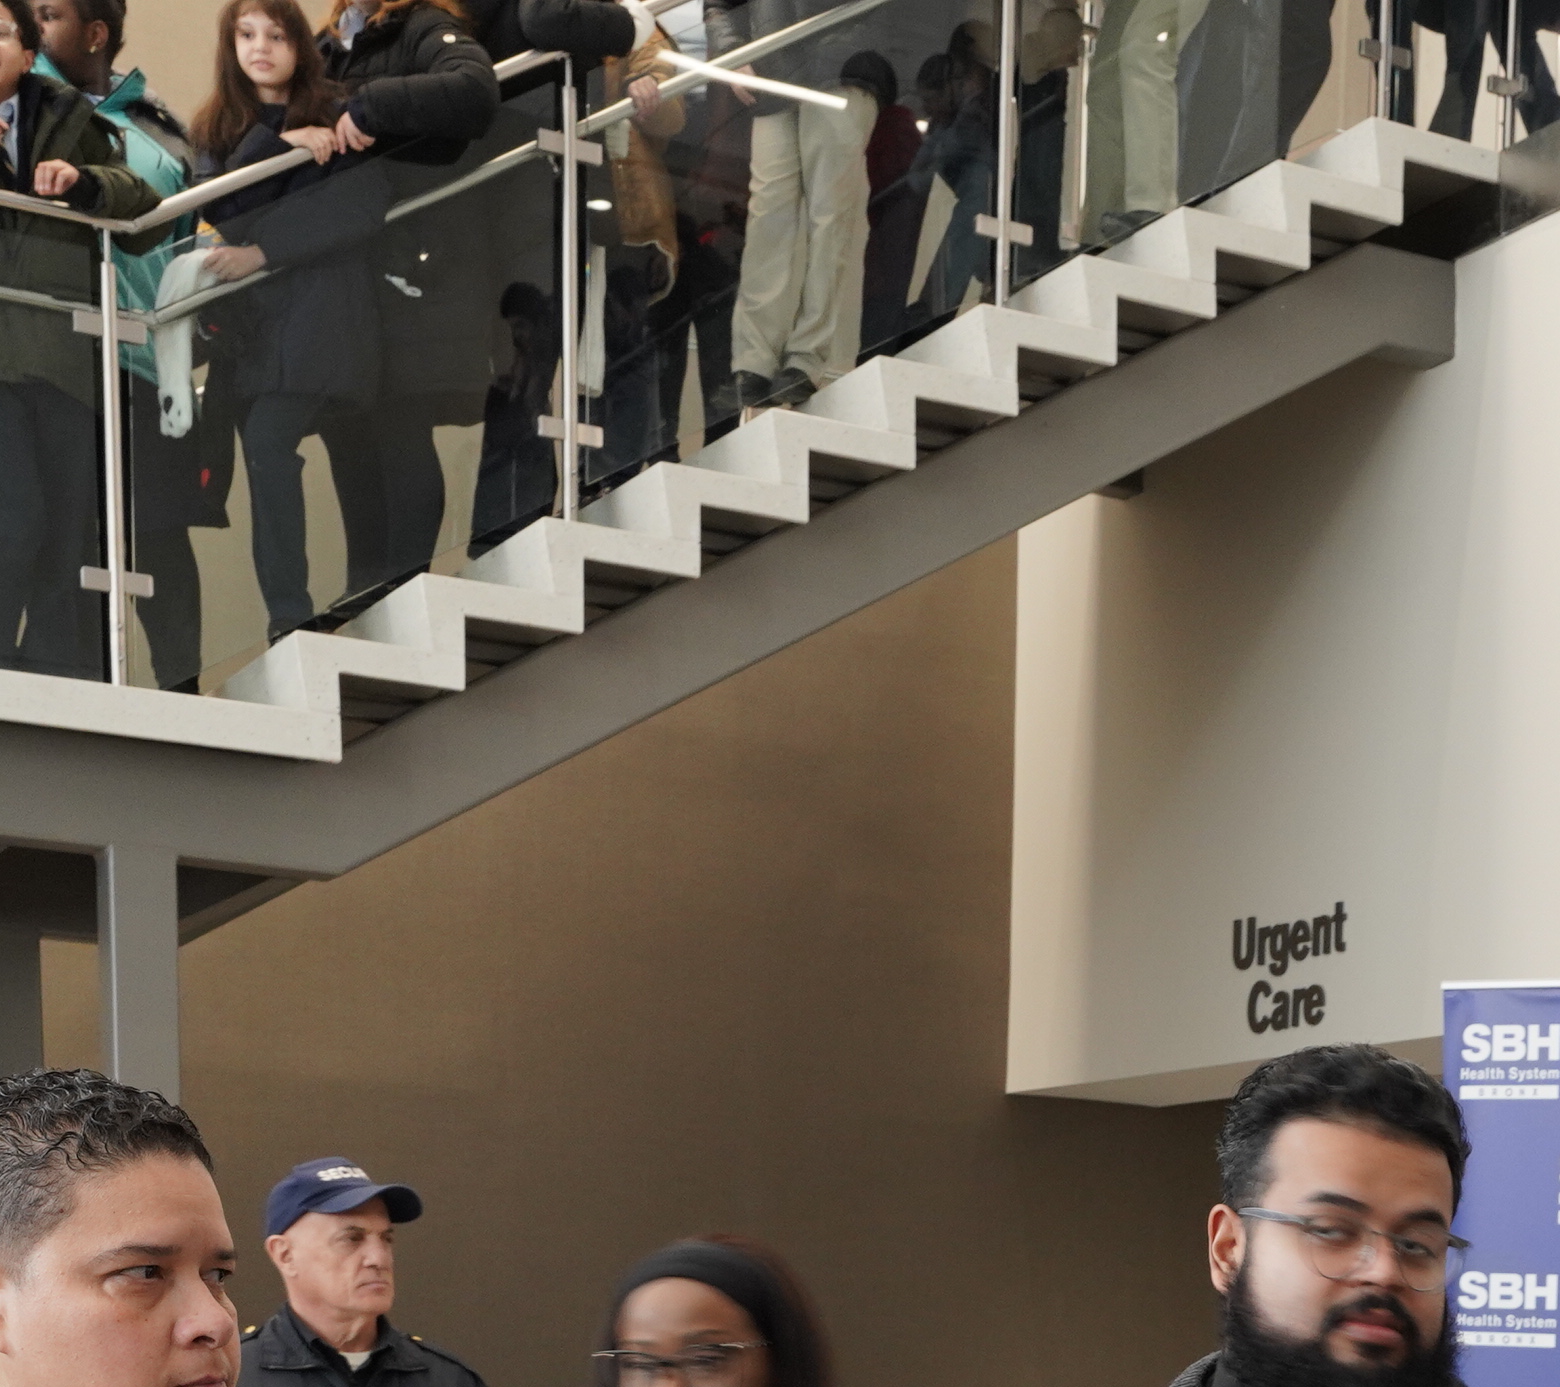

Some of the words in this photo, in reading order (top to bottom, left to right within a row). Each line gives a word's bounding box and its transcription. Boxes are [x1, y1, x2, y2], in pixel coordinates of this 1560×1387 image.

[1233, 901, 1347, 977] Urgent
[1247, 980, 1326, 1034] Care
[1462, 1023, 1560, 1062] SBH
[1460, 1067, 1505, 1080] Health
[1509, 1066, 1560, 1083] System
[1458, 1271, 1558, 1311] SBH
[1456, 1314, 1502, 1327] Health
[1505, 1314, 1557, 1329] System
